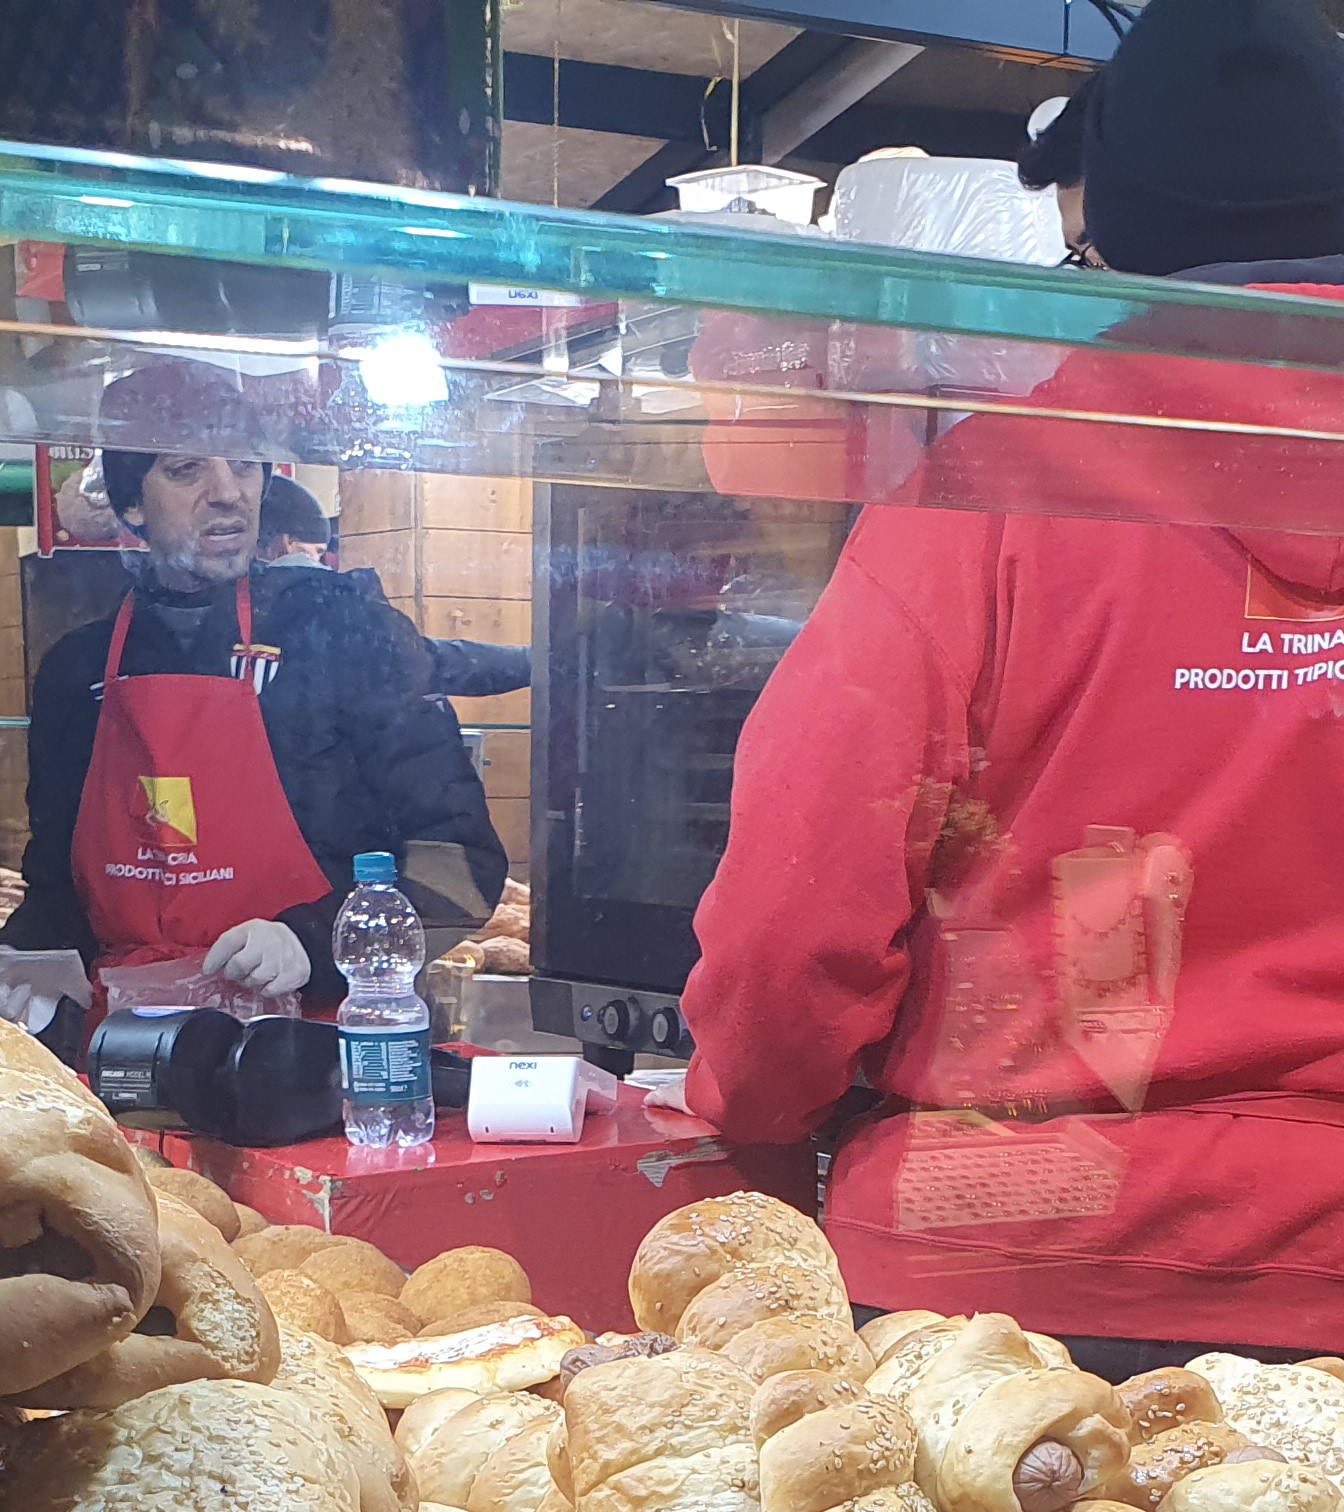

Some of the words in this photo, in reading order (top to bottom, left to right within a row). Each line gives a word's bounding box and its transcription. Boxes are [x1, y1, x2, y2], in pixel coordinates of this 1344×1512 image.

[1241, 632, 1273, 653] LA
[1174, 668, 1288, 690] PRODOTTI
[178, 867, 234, 885] SICILIANI
[509, 1061, 537, 1070] nexi
